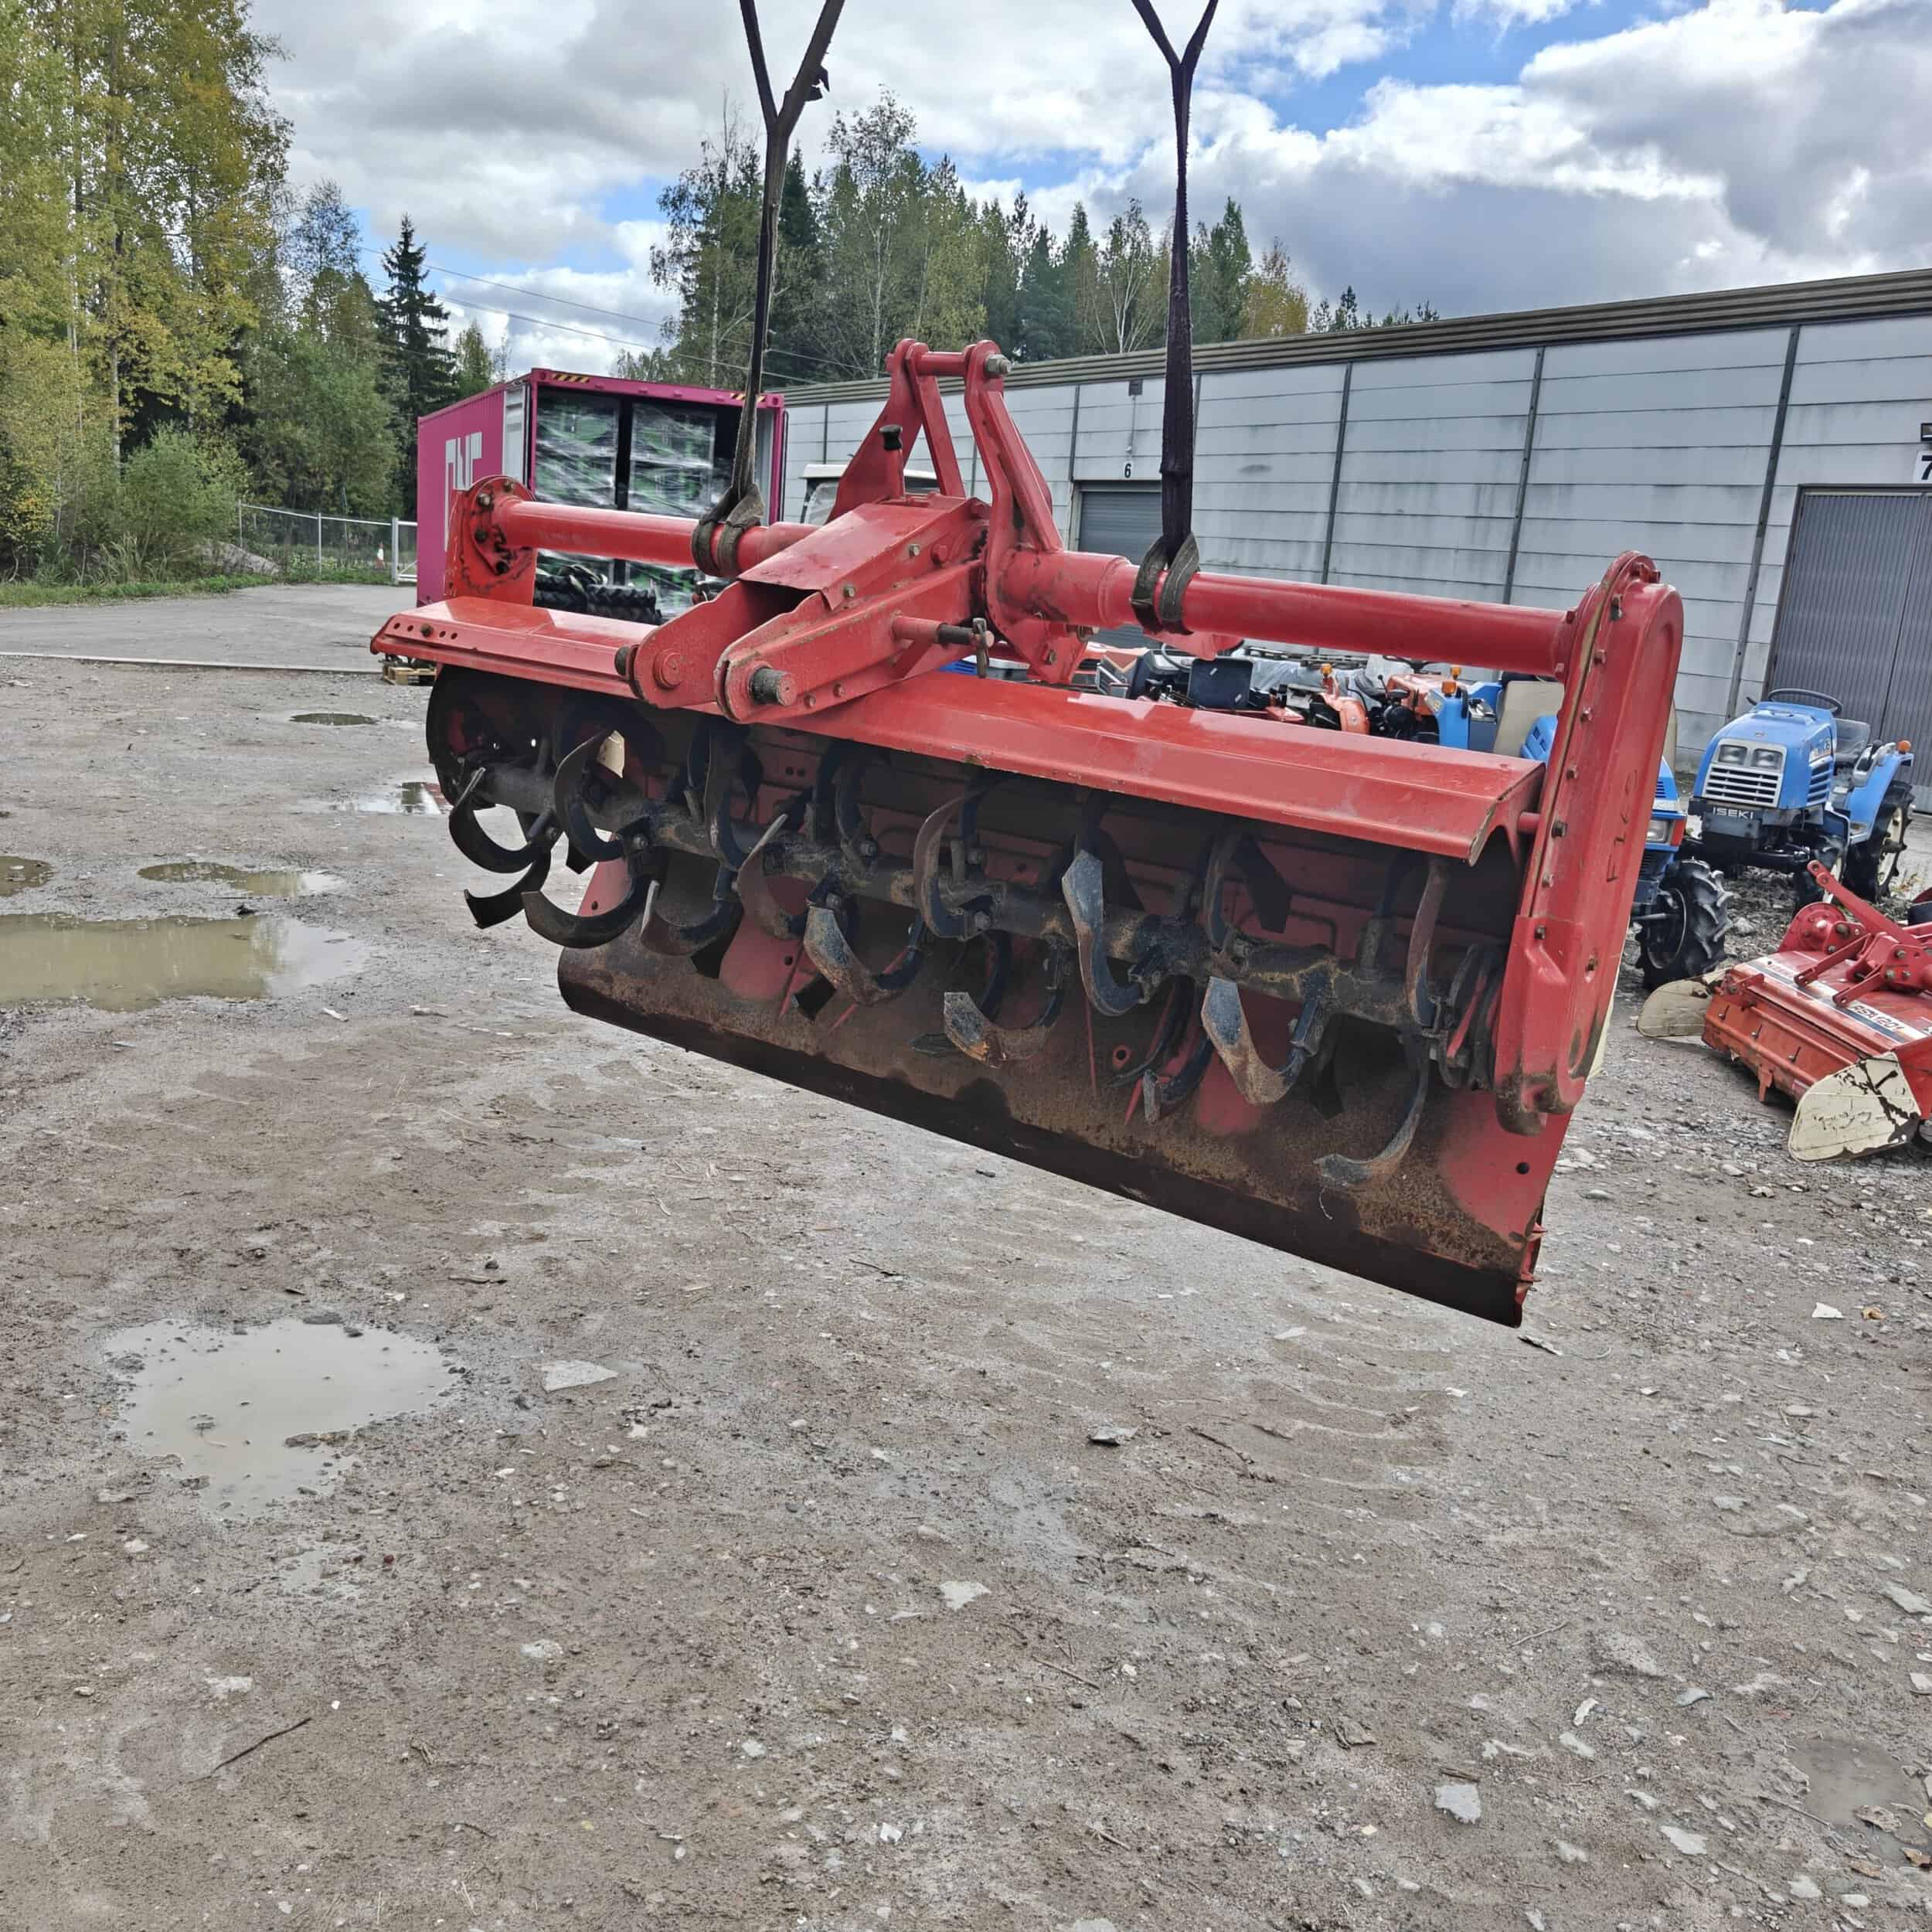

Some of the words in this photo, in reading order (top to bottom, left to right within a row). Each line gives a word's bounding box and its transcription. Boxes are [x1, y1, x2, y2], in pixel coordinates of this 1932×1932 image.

[1124, 462, 1131, 478] 6
[1921, 454, 1932, 480] 7
[1712, 806, 1754, 820] ISEKI
